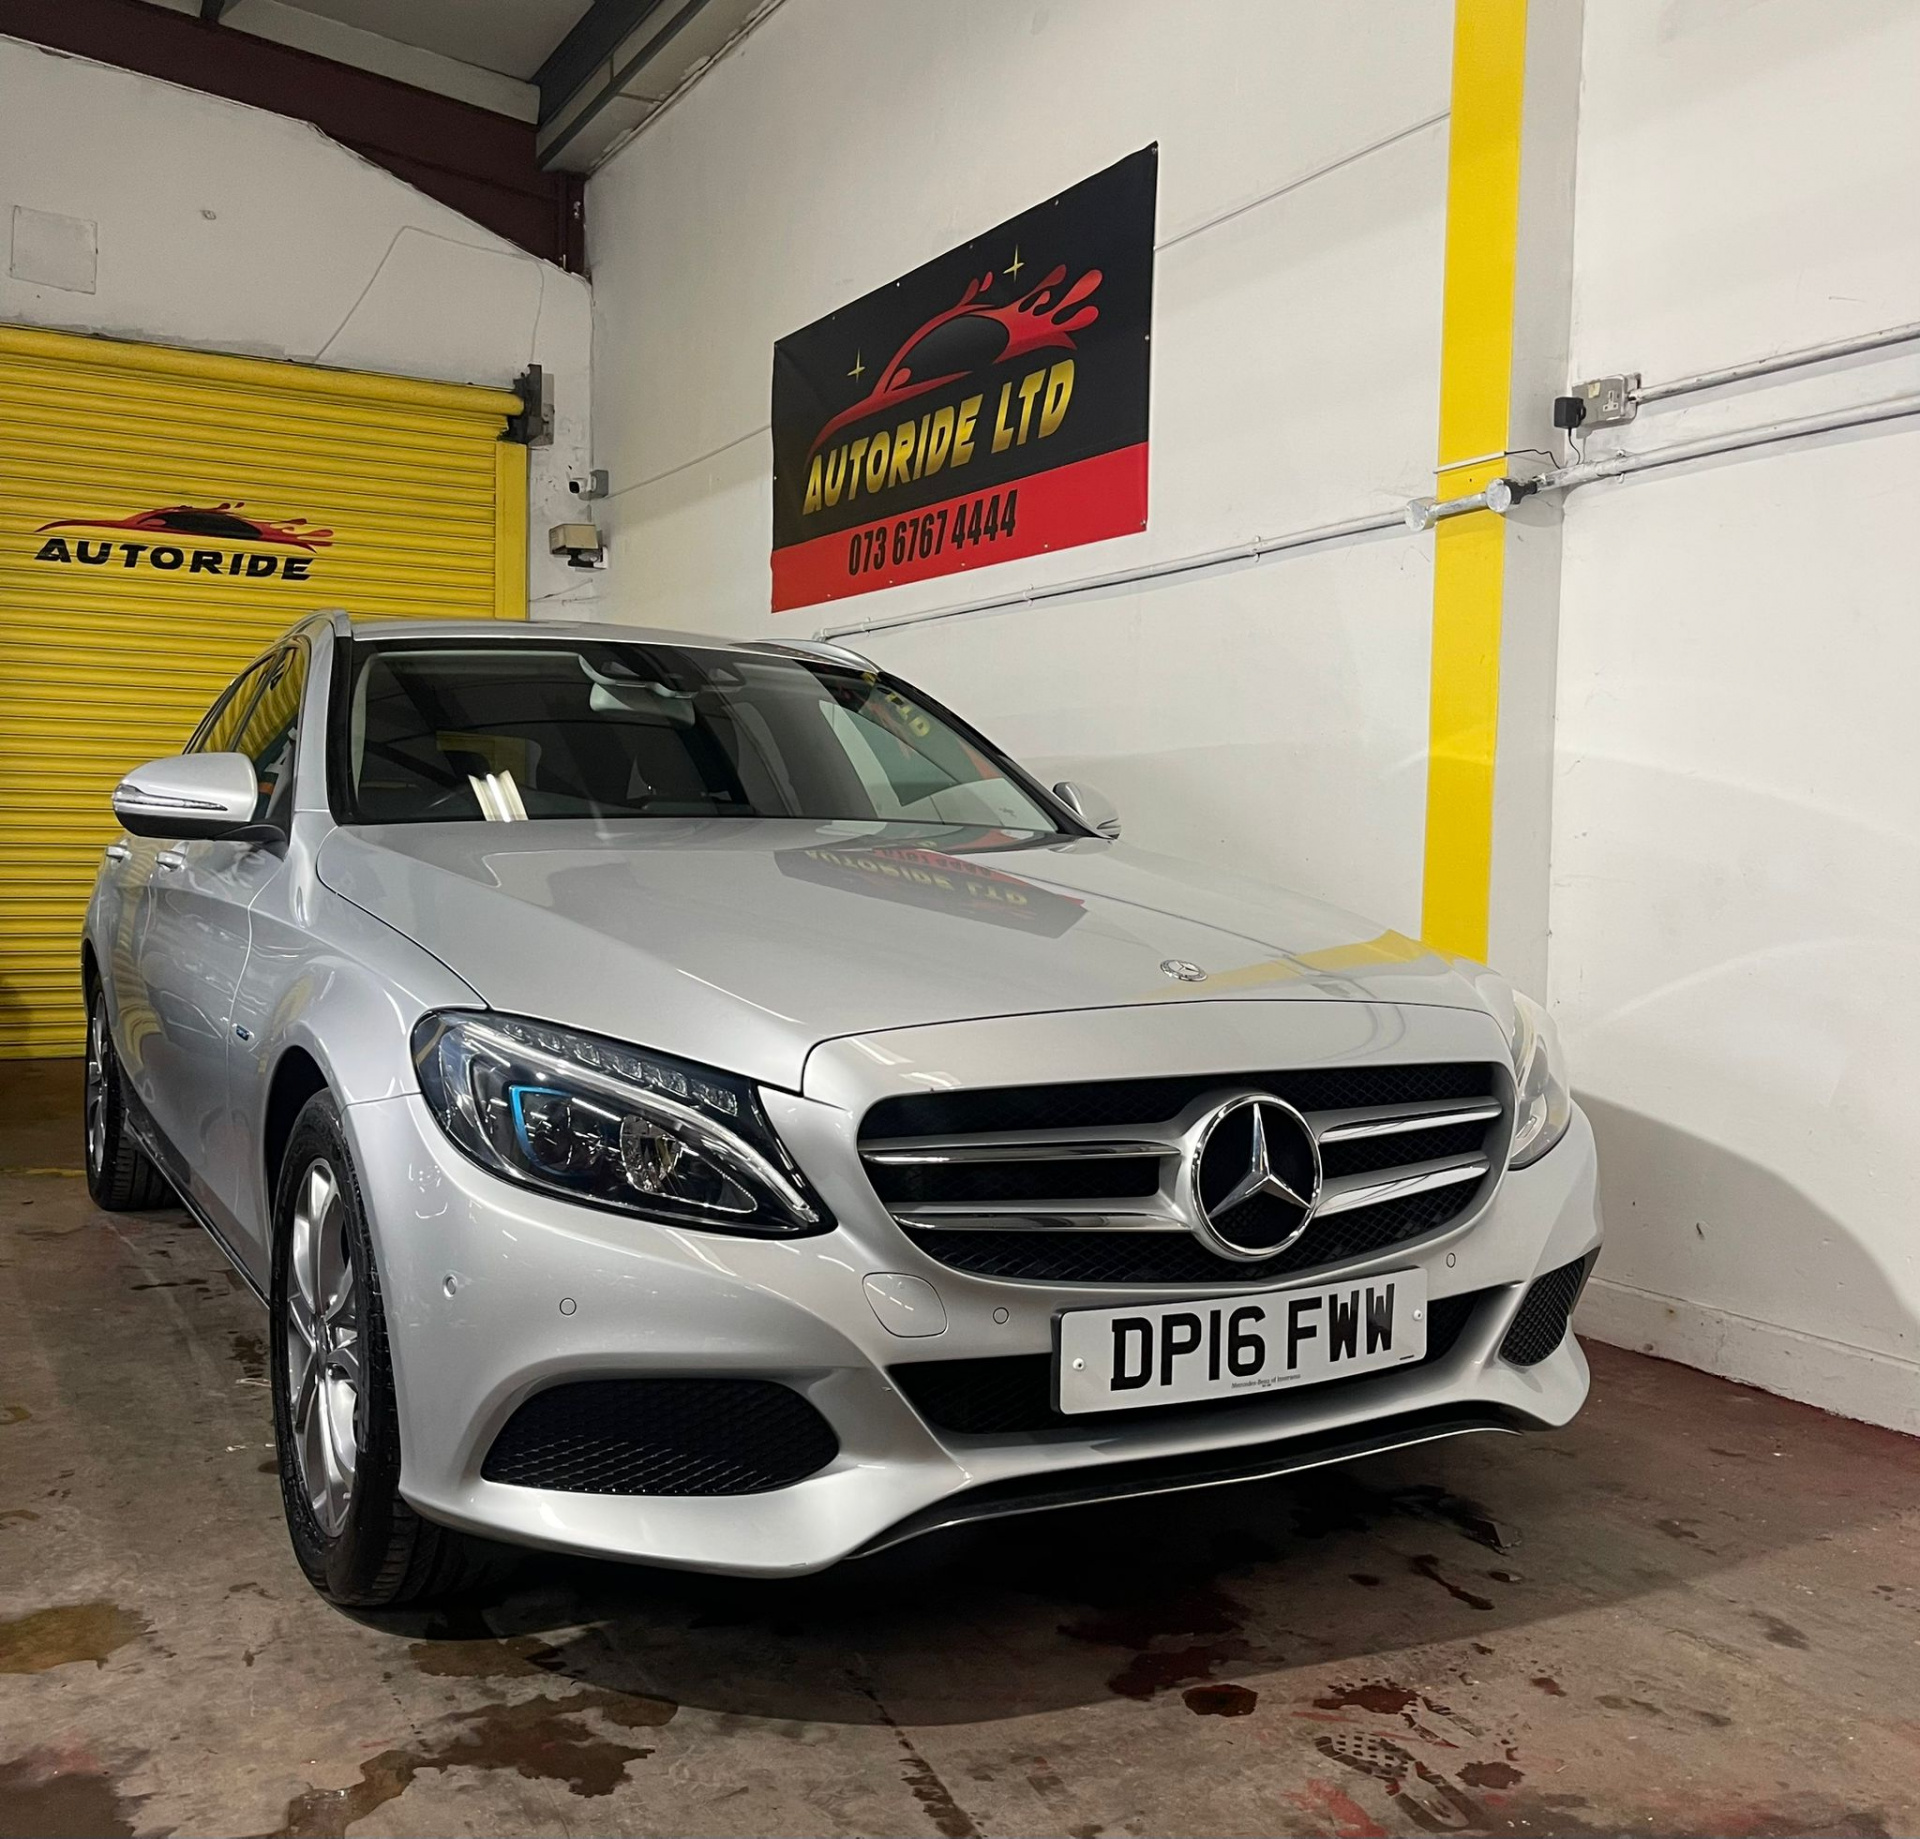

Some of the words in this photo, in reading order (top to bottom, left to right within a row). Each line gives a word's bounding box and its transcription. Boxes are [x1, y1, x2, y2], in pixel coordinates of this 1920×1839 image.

[802, 394, 984, 516] AUTORIDE
[991, 359, 1075, 454] LTD
[34, 538, 314, 581] AUTORIDE
[849, 526, 887, 576] 073
[892, 509, 948, 565] 6767
[951, 489, 1018, 550] 4444
[1110, 1305, 1266, 1391] DP16
[1287, 1282, 1396, 1370] FWW
